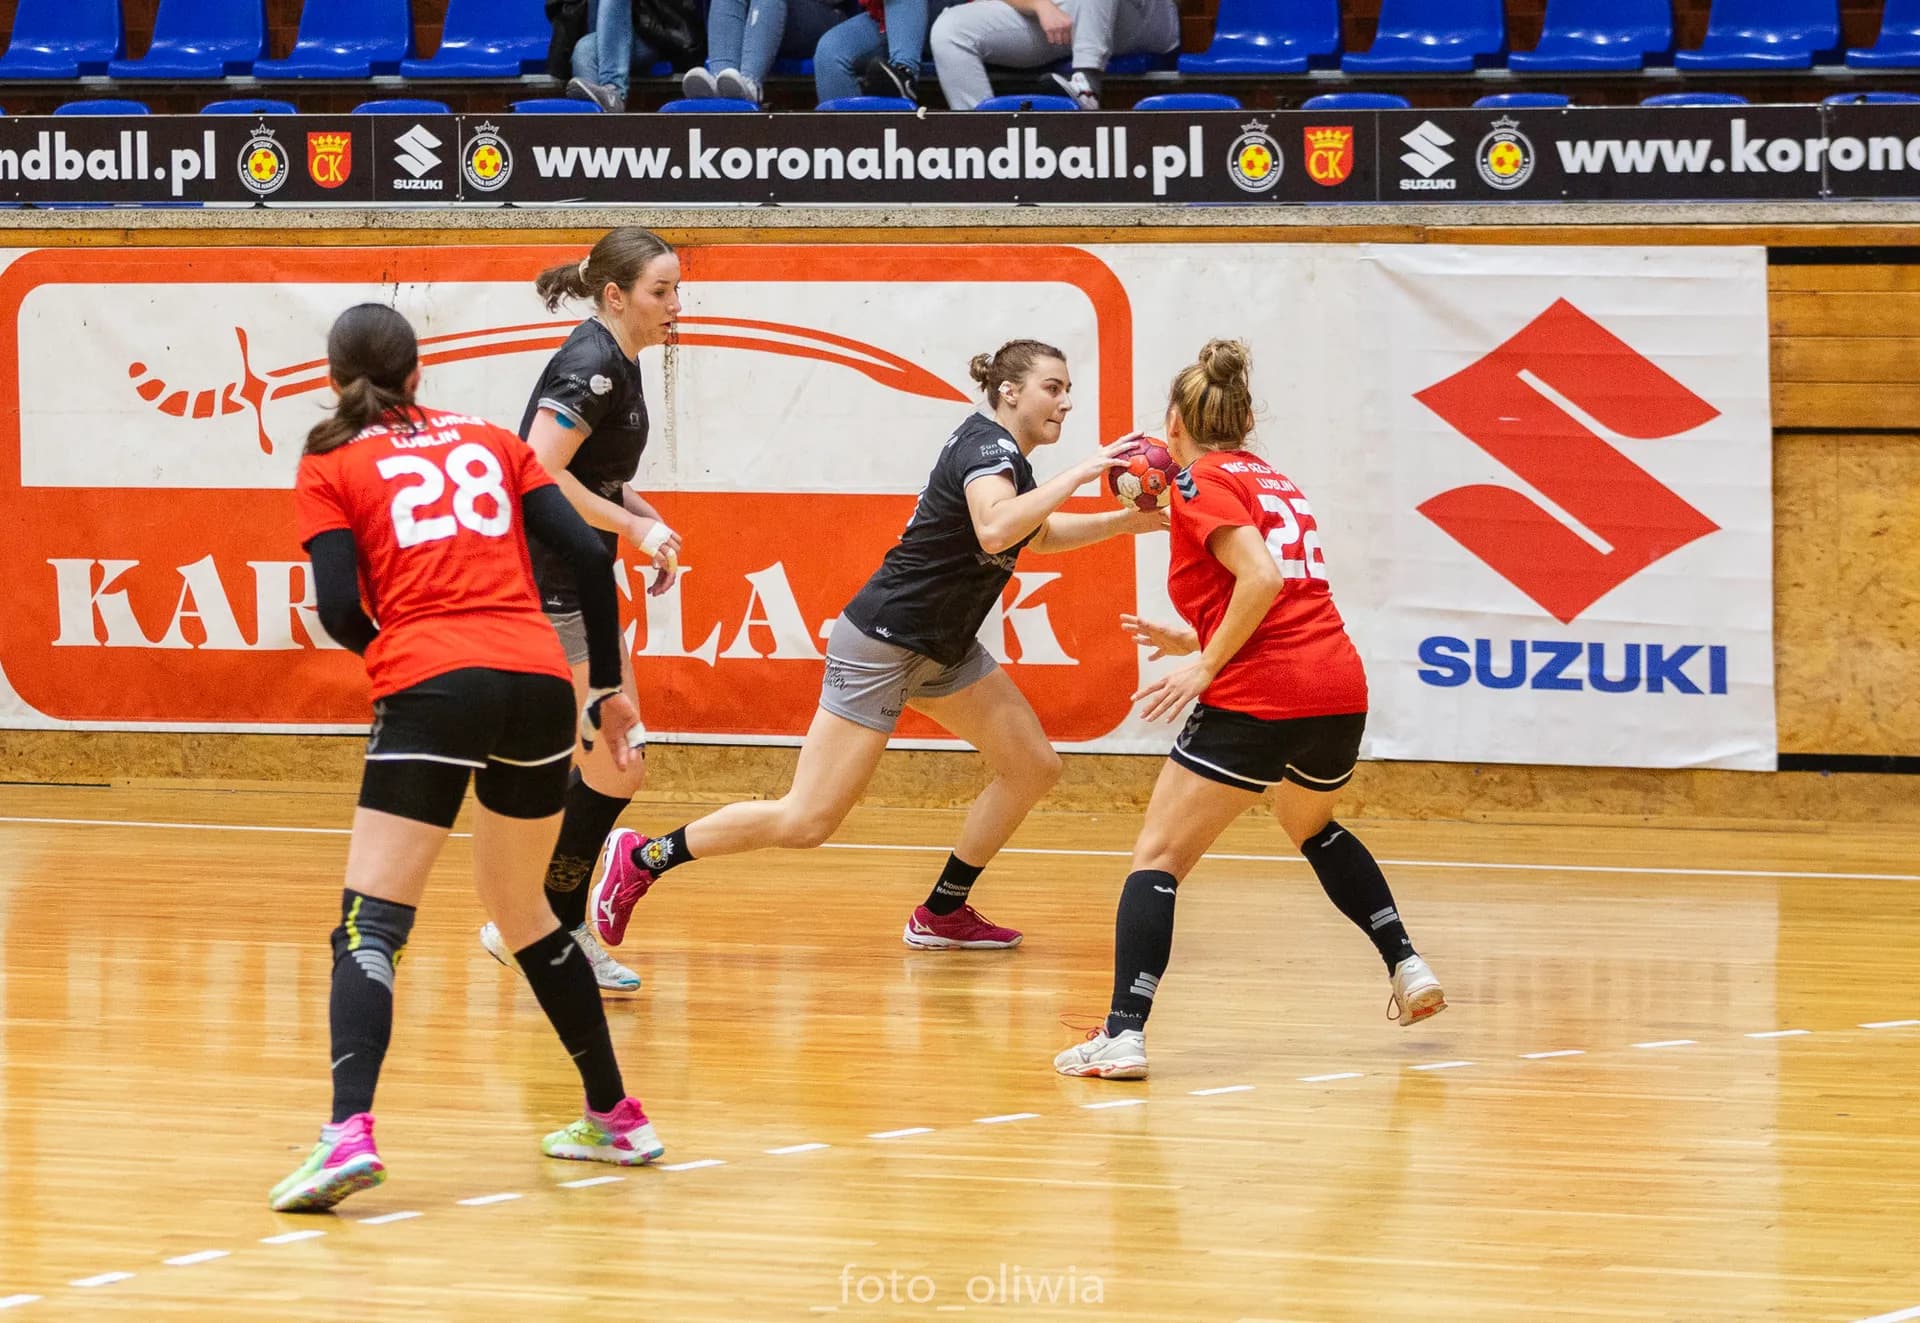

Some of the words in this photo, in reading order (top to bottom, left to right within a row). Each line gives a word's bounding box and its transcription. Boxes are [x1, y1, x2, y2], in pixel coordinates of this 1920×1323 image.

[0, 131, 216, 196] ndball.pl
[312, 153, 344, 182] CK
[532, 126, 1203, 196] www.koronahandball.pl
[1309, 150, 1345, 179] CK
[393, 179, 444, 190] SUZUKI
[1399, 179, 1456, 190] SUZUKI
[390, 428, 462, 449] LUBLIN
[376, 443, 513, 549] 28
[1257, 494, 1329, 579] 22
[1417, 636, 1728, 695] SUZUKI
